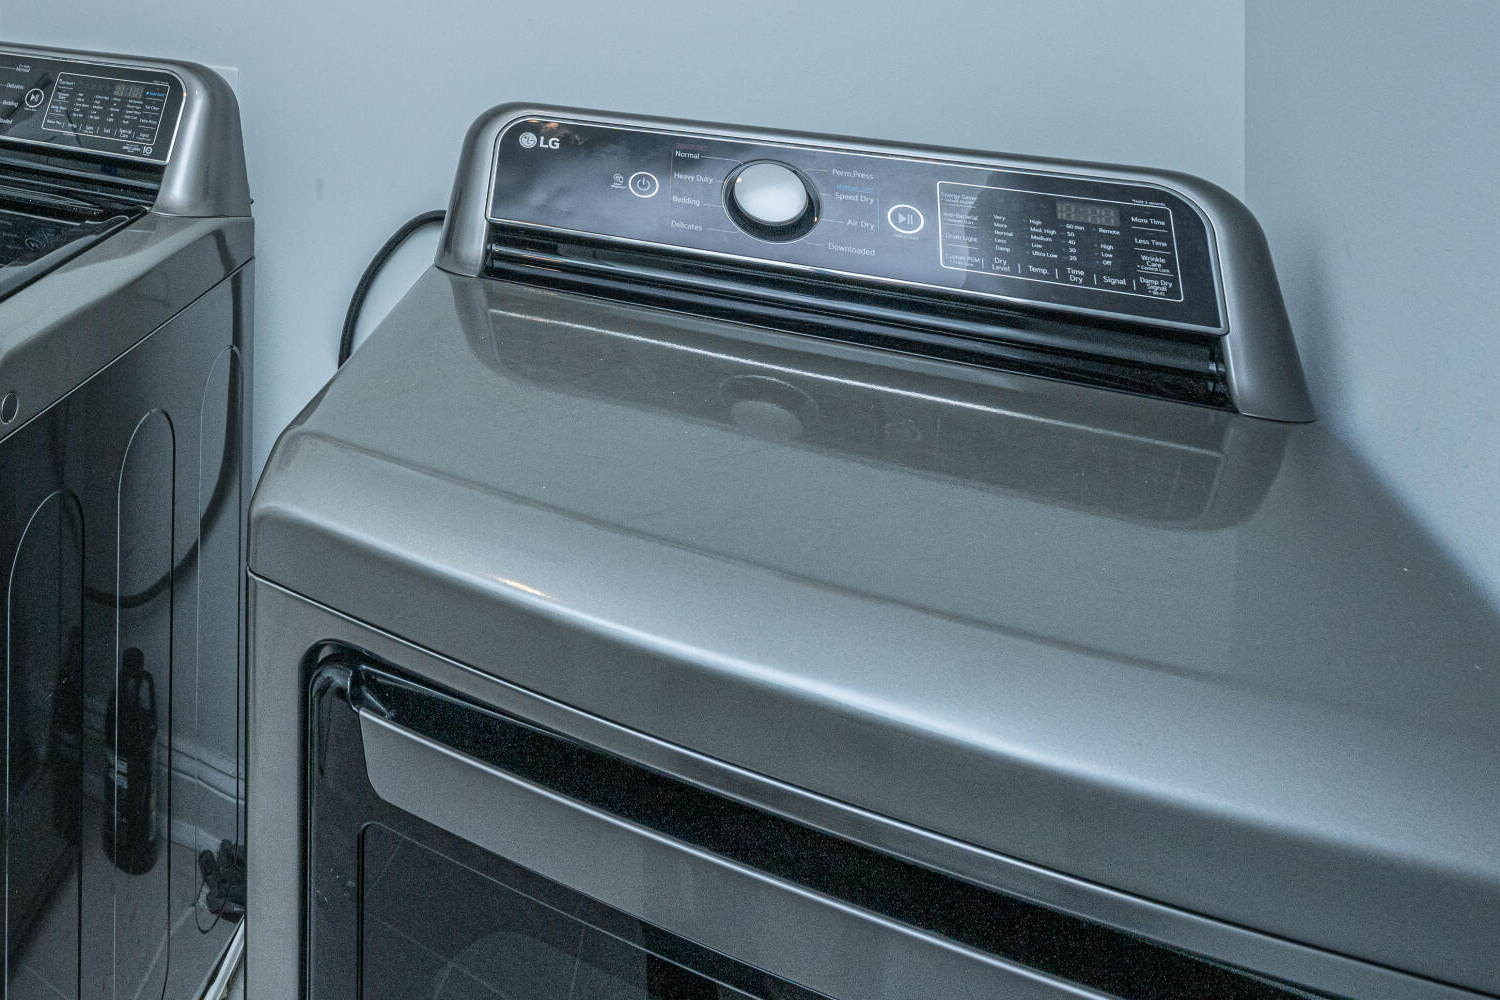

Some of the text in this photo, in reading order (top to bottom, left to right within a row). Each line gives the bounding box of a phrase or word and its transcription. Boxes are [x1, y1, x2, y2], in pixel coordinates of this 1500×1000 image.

[540, 137, 560, 149] LG
[675, 150, 700, 159] Normal
[673, 172, 713, 185] Heavy Duty
[672, 195, 700, 206] Bedding
[835, 192, 874, 204] Speed Dry
[671, 221, 703, 231] Delicates
[846, 218, 874, 230] Air Dry
[1131, 216, 1166, 226] More Time
[1098, 227, 1120, 235] Remote
[1134, 237, 1150, 245] Less
[828, 243, 876, 256] Downloaded
[994, 257, 1007, 265] Dry
[1140, 254, 1166, 263] Wrinkle
[991, 264, 1011, 272] Level
[1065, 267, 1085, 276] Time
[1069, 274, 1083, 284] Dry
[1102, 275, 1127, 286] Signal
[1139, 276, 1173, 288] Damp Dry
[1146, 283, 1167, 292] Signal
